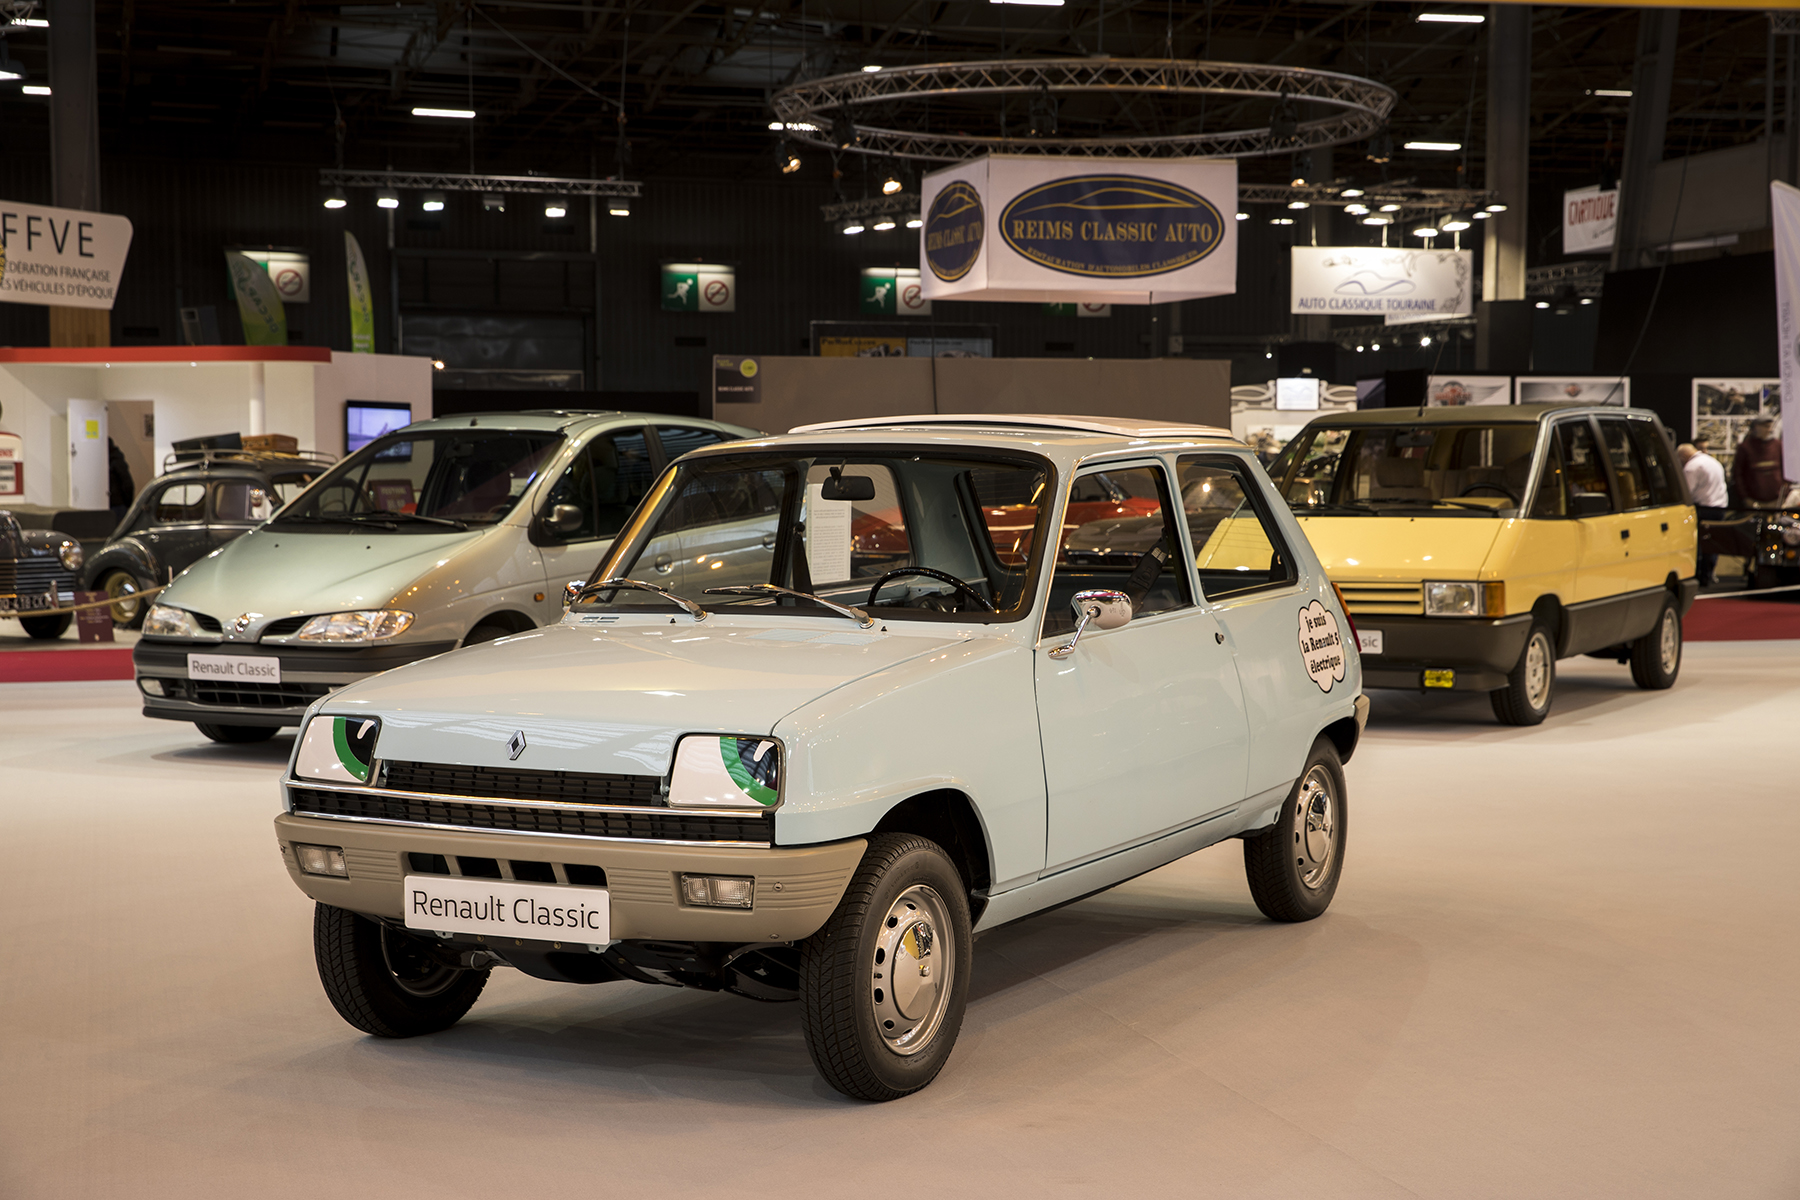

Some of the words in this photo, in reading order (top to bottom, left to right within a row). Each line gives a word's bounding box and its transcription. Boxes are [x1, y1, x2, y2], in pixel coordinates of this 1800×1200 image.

[2, 212, 95, 258] FFVE
[1012, 219, 1074, 241] REIMS
[1081, 220, 1158, 243] CLASSIC
[1164, 222, 1213, 244] AUTO
[1026, 246, 1086, 269] RESTAURATION
[60, 264, 111, 283] FRANÇAISE
[13, 277, 65, 296] VÉHICULES
[1298, 297, 1327, 310] AUTO
[1328, 297, 1382, 312] CLASSIQUE
[1386, 298, 1436, 311] TOURAINE
[1305, 616, 1313, 633] je
[1313, 613, 1326, 628] suis
[1301, 640, 1310, 653] la
[1309, 632, 1335, 651] Renault
[1334, 632, 1340, 646] 5
[192, 660, 234, 675] Renault
[236, 662, 276, 677] Classic
[1310, 655, 1341, 674] électrique
[412, 890, 505, 922] Renault
[513, 898, 600, 930] Classic
